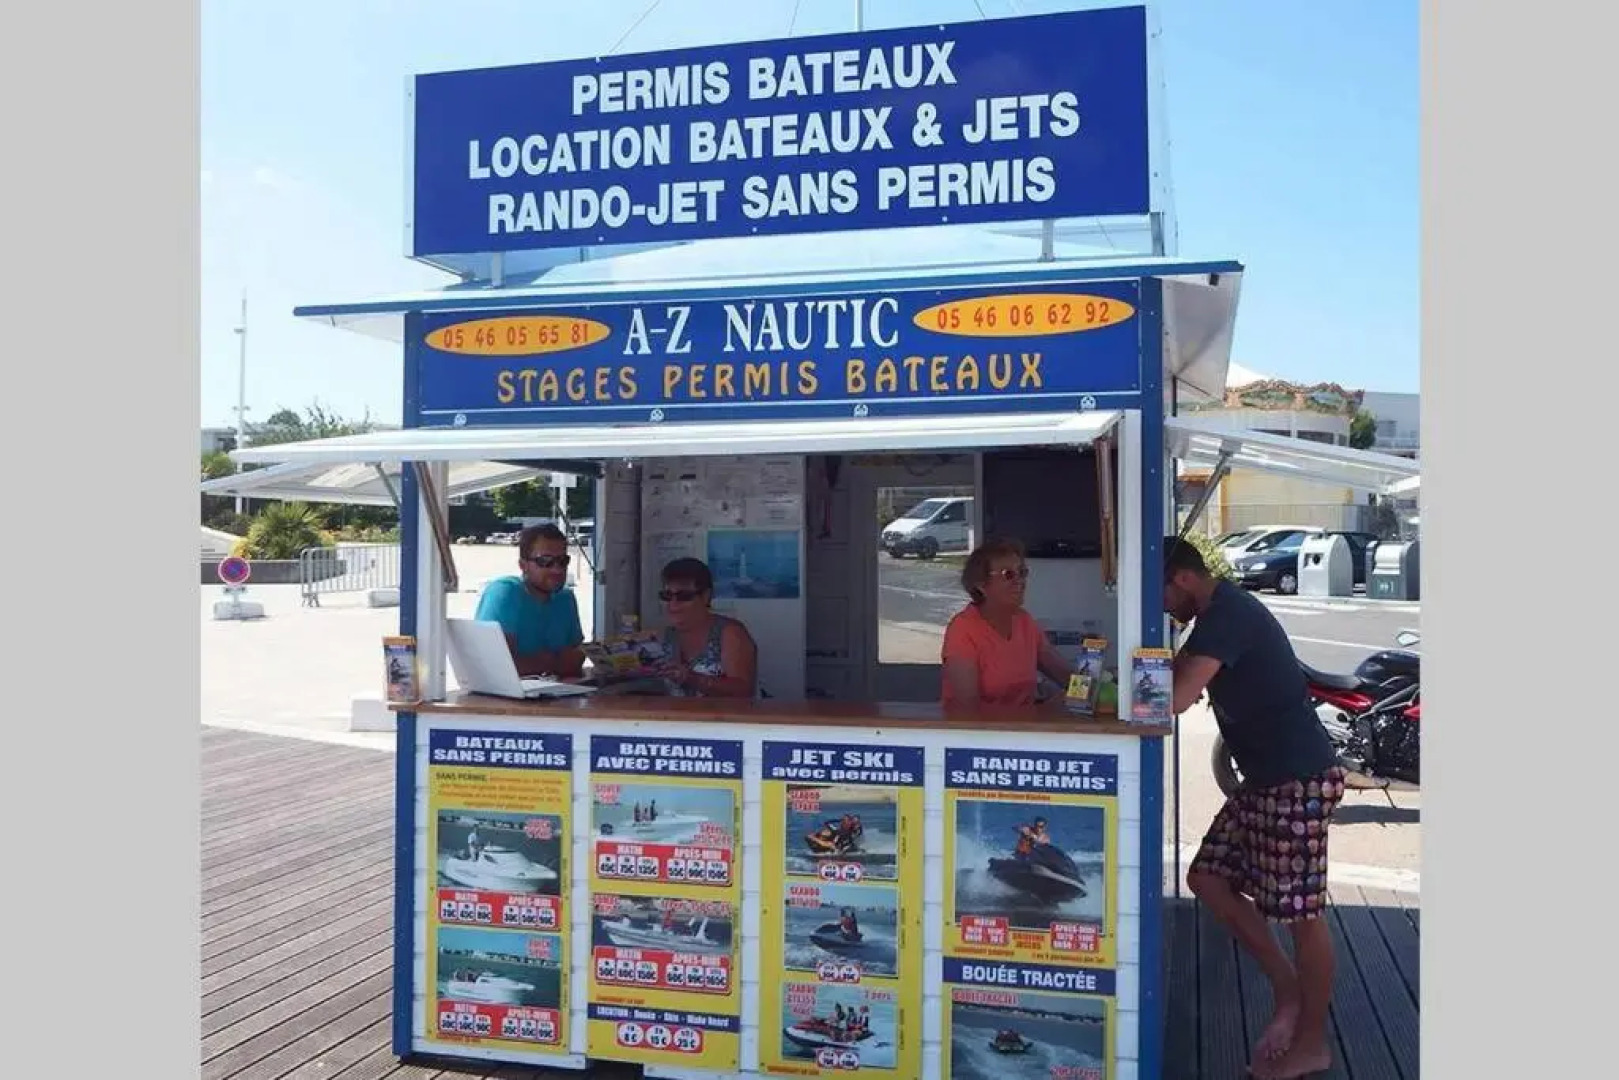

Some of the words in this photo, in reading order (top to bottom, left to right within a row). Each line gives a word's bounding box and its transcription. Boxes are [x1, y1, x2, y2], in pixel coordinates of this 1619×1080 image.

[573, 61, 730, 115] PERMIS
[749, 41, 958, 100] BATEAUX
[469, 124, 670, 179] LOCATION
[690, 106, 894, 163] BATEAUX
[912, 102, 943, 147] &
[962, 91, 1080, 143] JETS
[489, 179, 725, 234] RANDO-JET
[742, 169, 859, 219] SANS
[878, 157, 1055, 210] PERMIS
[623, 306, 692, 355] A-Z
[723, 295, 898, 352] NAUTIC
[937, 308, 960, 329] 05
[973, 306, 997, 327] 46
[1009, 304, 1034, 326] 06
[1047, 303, 1071, 324] 62
[1085, 301, 1109, 323] 92
[443, 328, 464, 349] 05
[475, 327, 496, 347] 46
[507, 325, 528, 346] 05
[538, 325, 559, 345] 65
[571, 323, 588, 343] 81
[497, 366, 638, 404] STAGES
[663, 361, 819, 400] PERMIS
[846, 353, 1043, 395] BATEAUX
[456, 736, 544, 752] BATEAUX
[619, 743, 713, 758] BATEAUX
[434, 748, 486, 762] SANS
[490, 752, 567, 766] PERMIS
[597, 756, 650, 771] AVEC
[655, 758, 736, 774] PERMIS
[789, 749, 836, 766] JET
[843, 751, 894, 768] SKI
[973, 756, 1050, 772] RANDO
[1056, 761, 1094, 774] JET
[772, 766, 825, 779] avec
[831, 769, 914, 782] permis
[951, 771, 1012, 786] SANS
[962, 964, 1018, 984] BOUÉE
[1021, 969, 1097, 990] TRACTÉE
